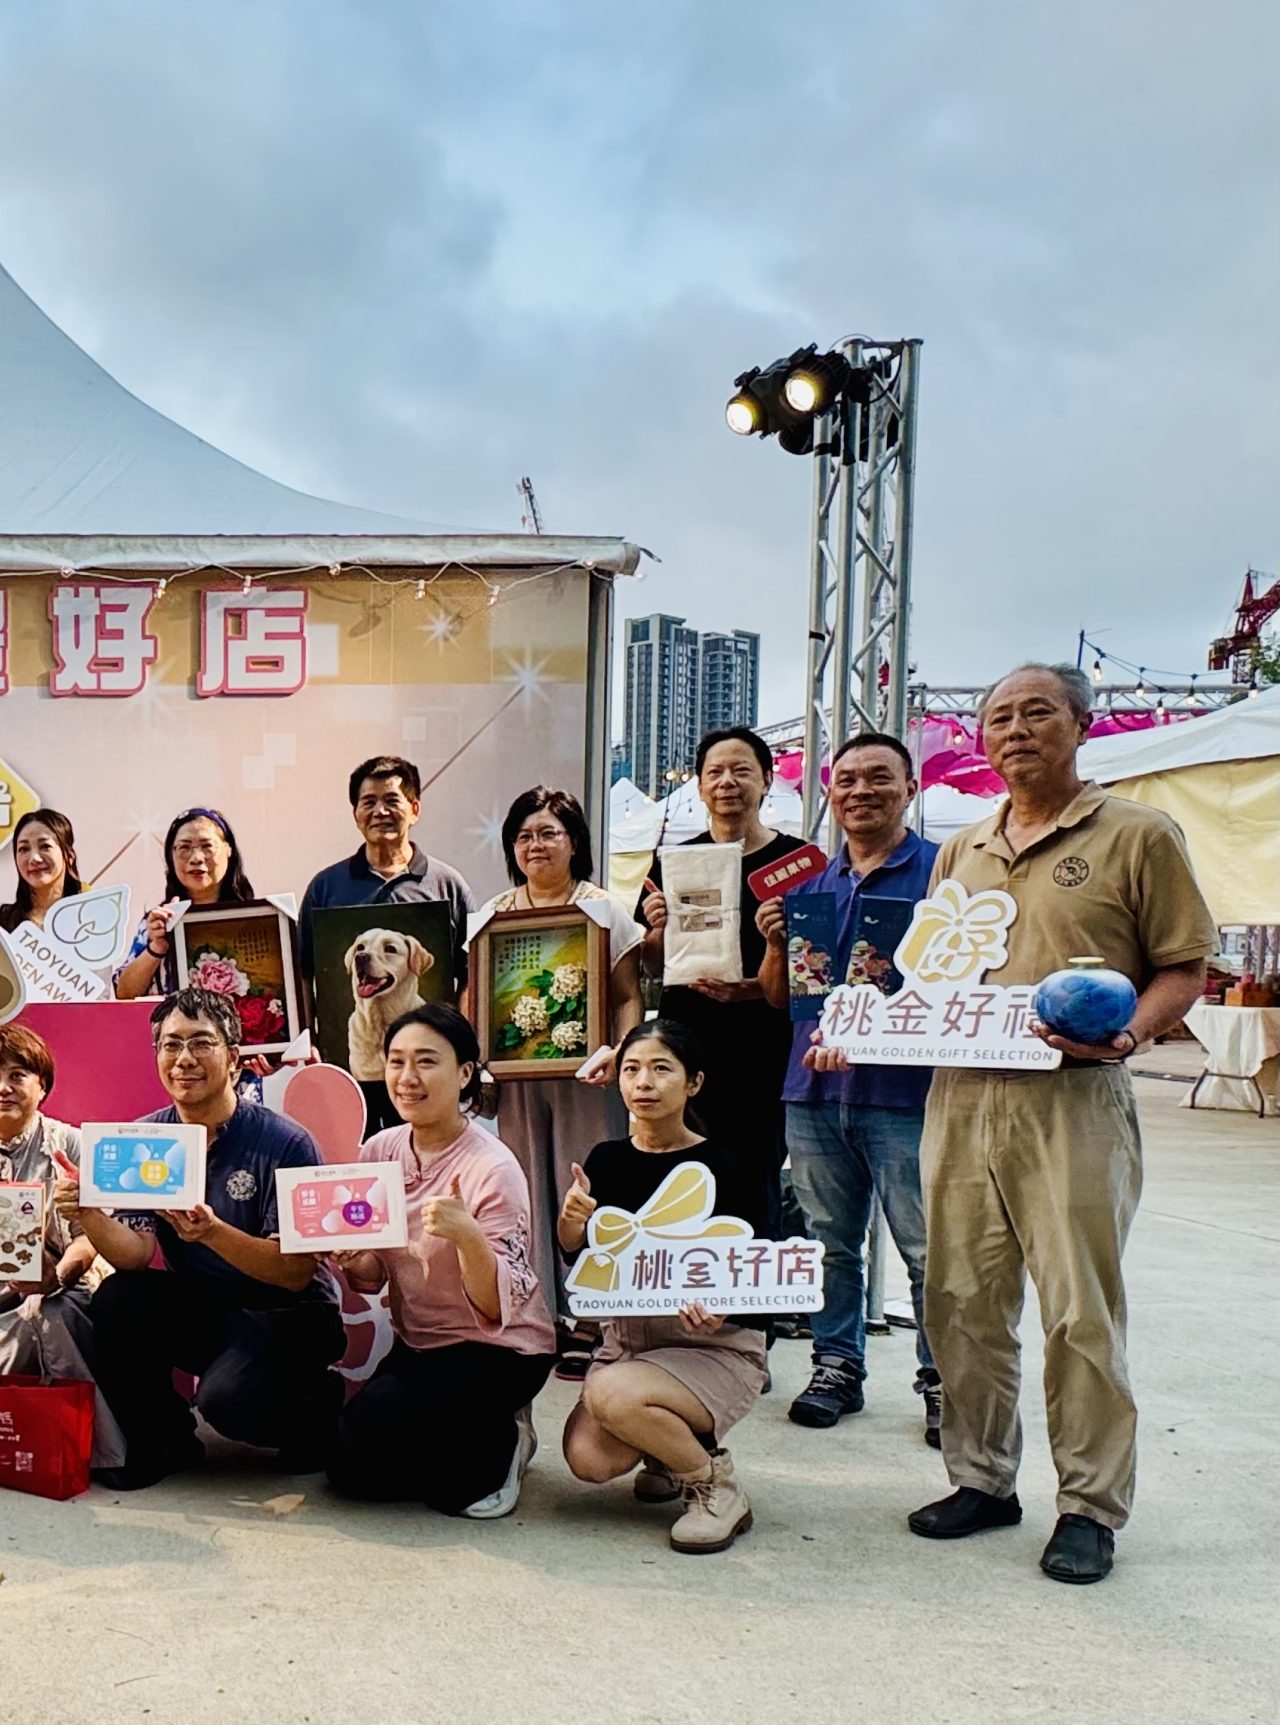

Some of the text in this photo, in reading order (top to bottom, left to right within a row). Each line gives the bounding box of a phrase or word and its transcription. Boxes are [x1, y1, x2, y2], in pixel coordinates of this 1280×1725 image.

[19, 930, 95, 997] TAOYUAN
[881, 1047, 933, 1058] GOLDEN
[938, 1049, 968, 1059] GIFT
[973, 1049, 1053, 1061] SELECTION
[632, 1244, 817, 1290] 桃金好店
[576, 1299, 633, 1309] TAOYUAN
[637, 1298, 688, 1308] GOLDEN
[740, 1294, 816, 1306] SELECTION
